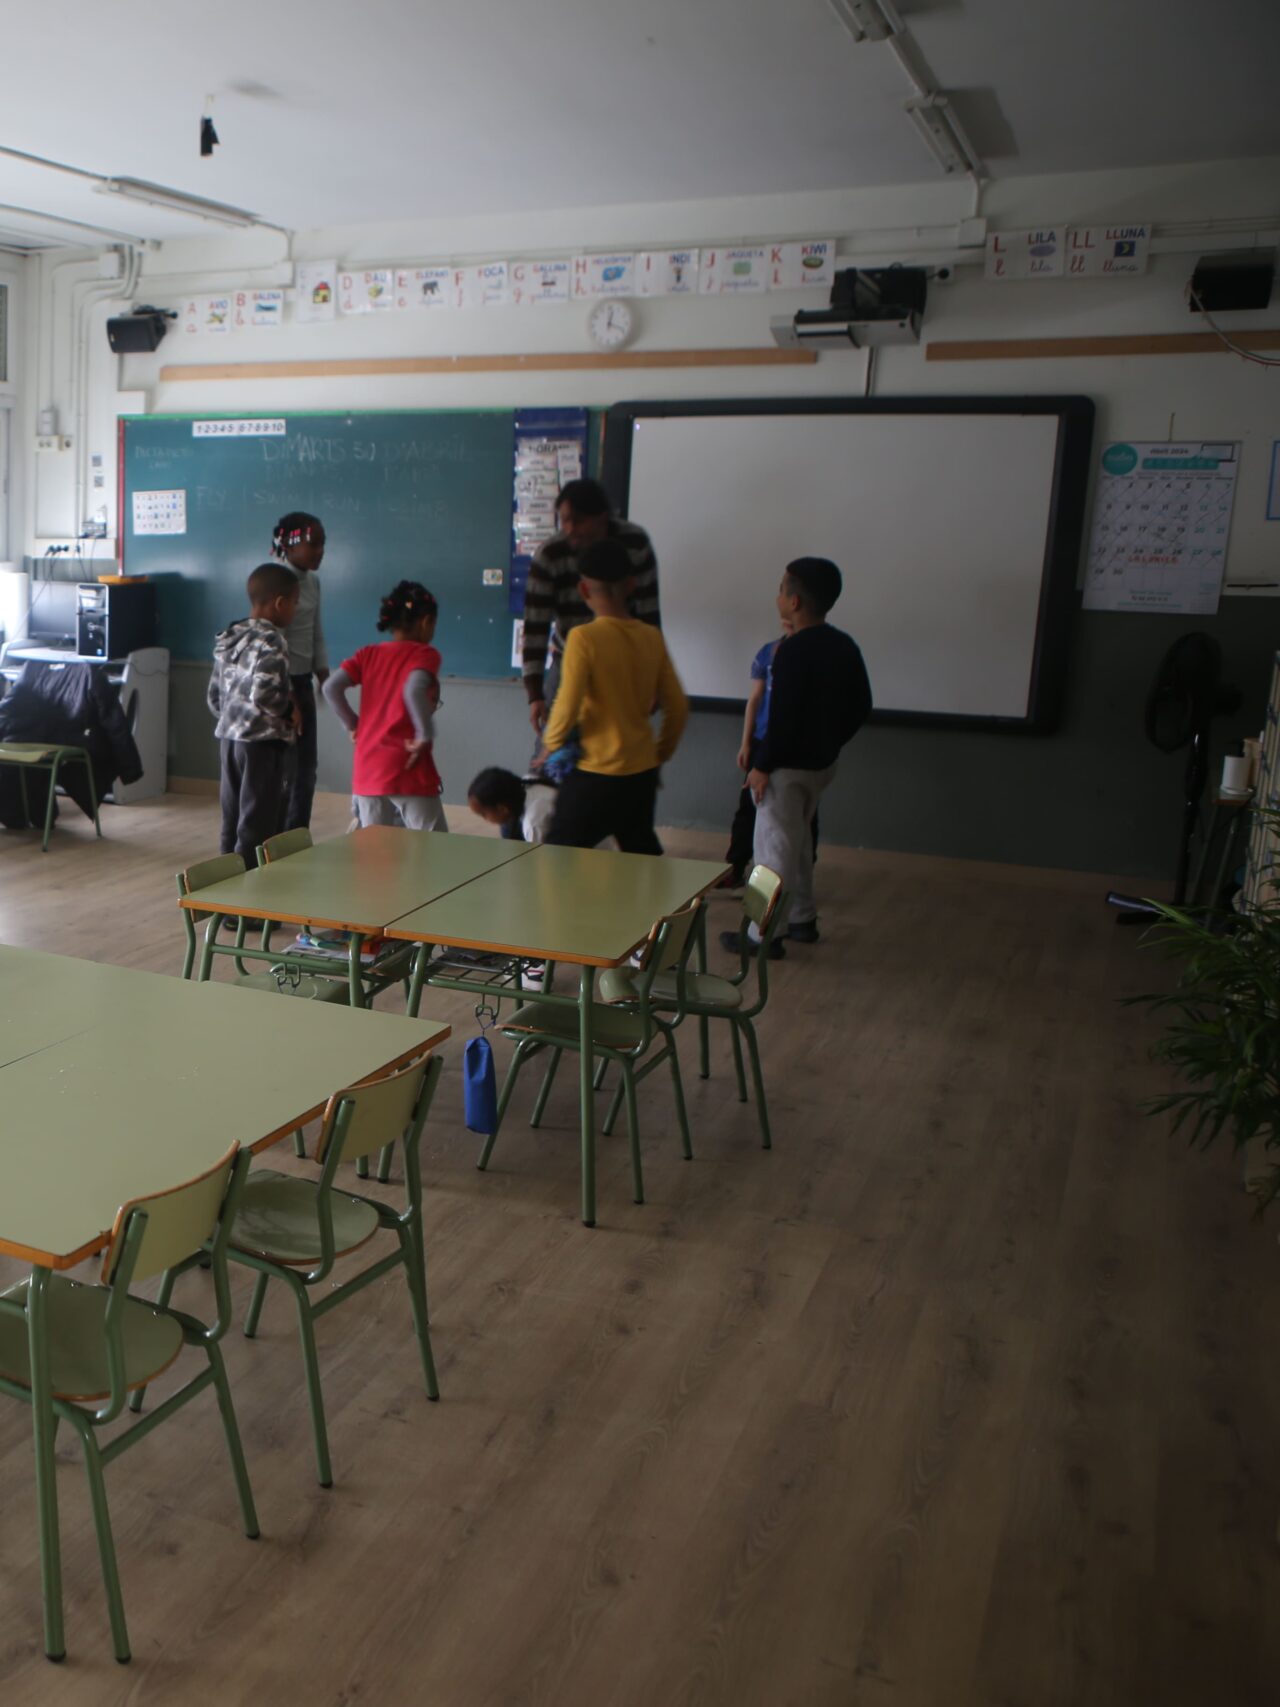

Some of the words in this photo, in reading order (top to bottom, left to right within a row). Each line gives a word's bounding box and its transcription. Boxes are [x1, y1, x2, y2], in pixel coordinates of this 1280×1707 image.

[992, 235, 1007, 254] L
[1028, 230, 1056, 245] LILA
[1072, 230, 1096, 249] LL
[1106, 227, 1146, 241] LLUNA
[705, 250, 716, 269] J
[771, 247, 783, 263] K
[801, 243, 827, 256] KIWI
[513, 265, 525, 282] G
[575, 258, 588, 275] H
[343, 276, 353, 290] D
[397, 275, 408, 288] E
[454, 271, 465, 287] F
[478, 266, 505, 279] FOCA
[187, 301, 197, 314] A
[236, 292, 246, 307] B
